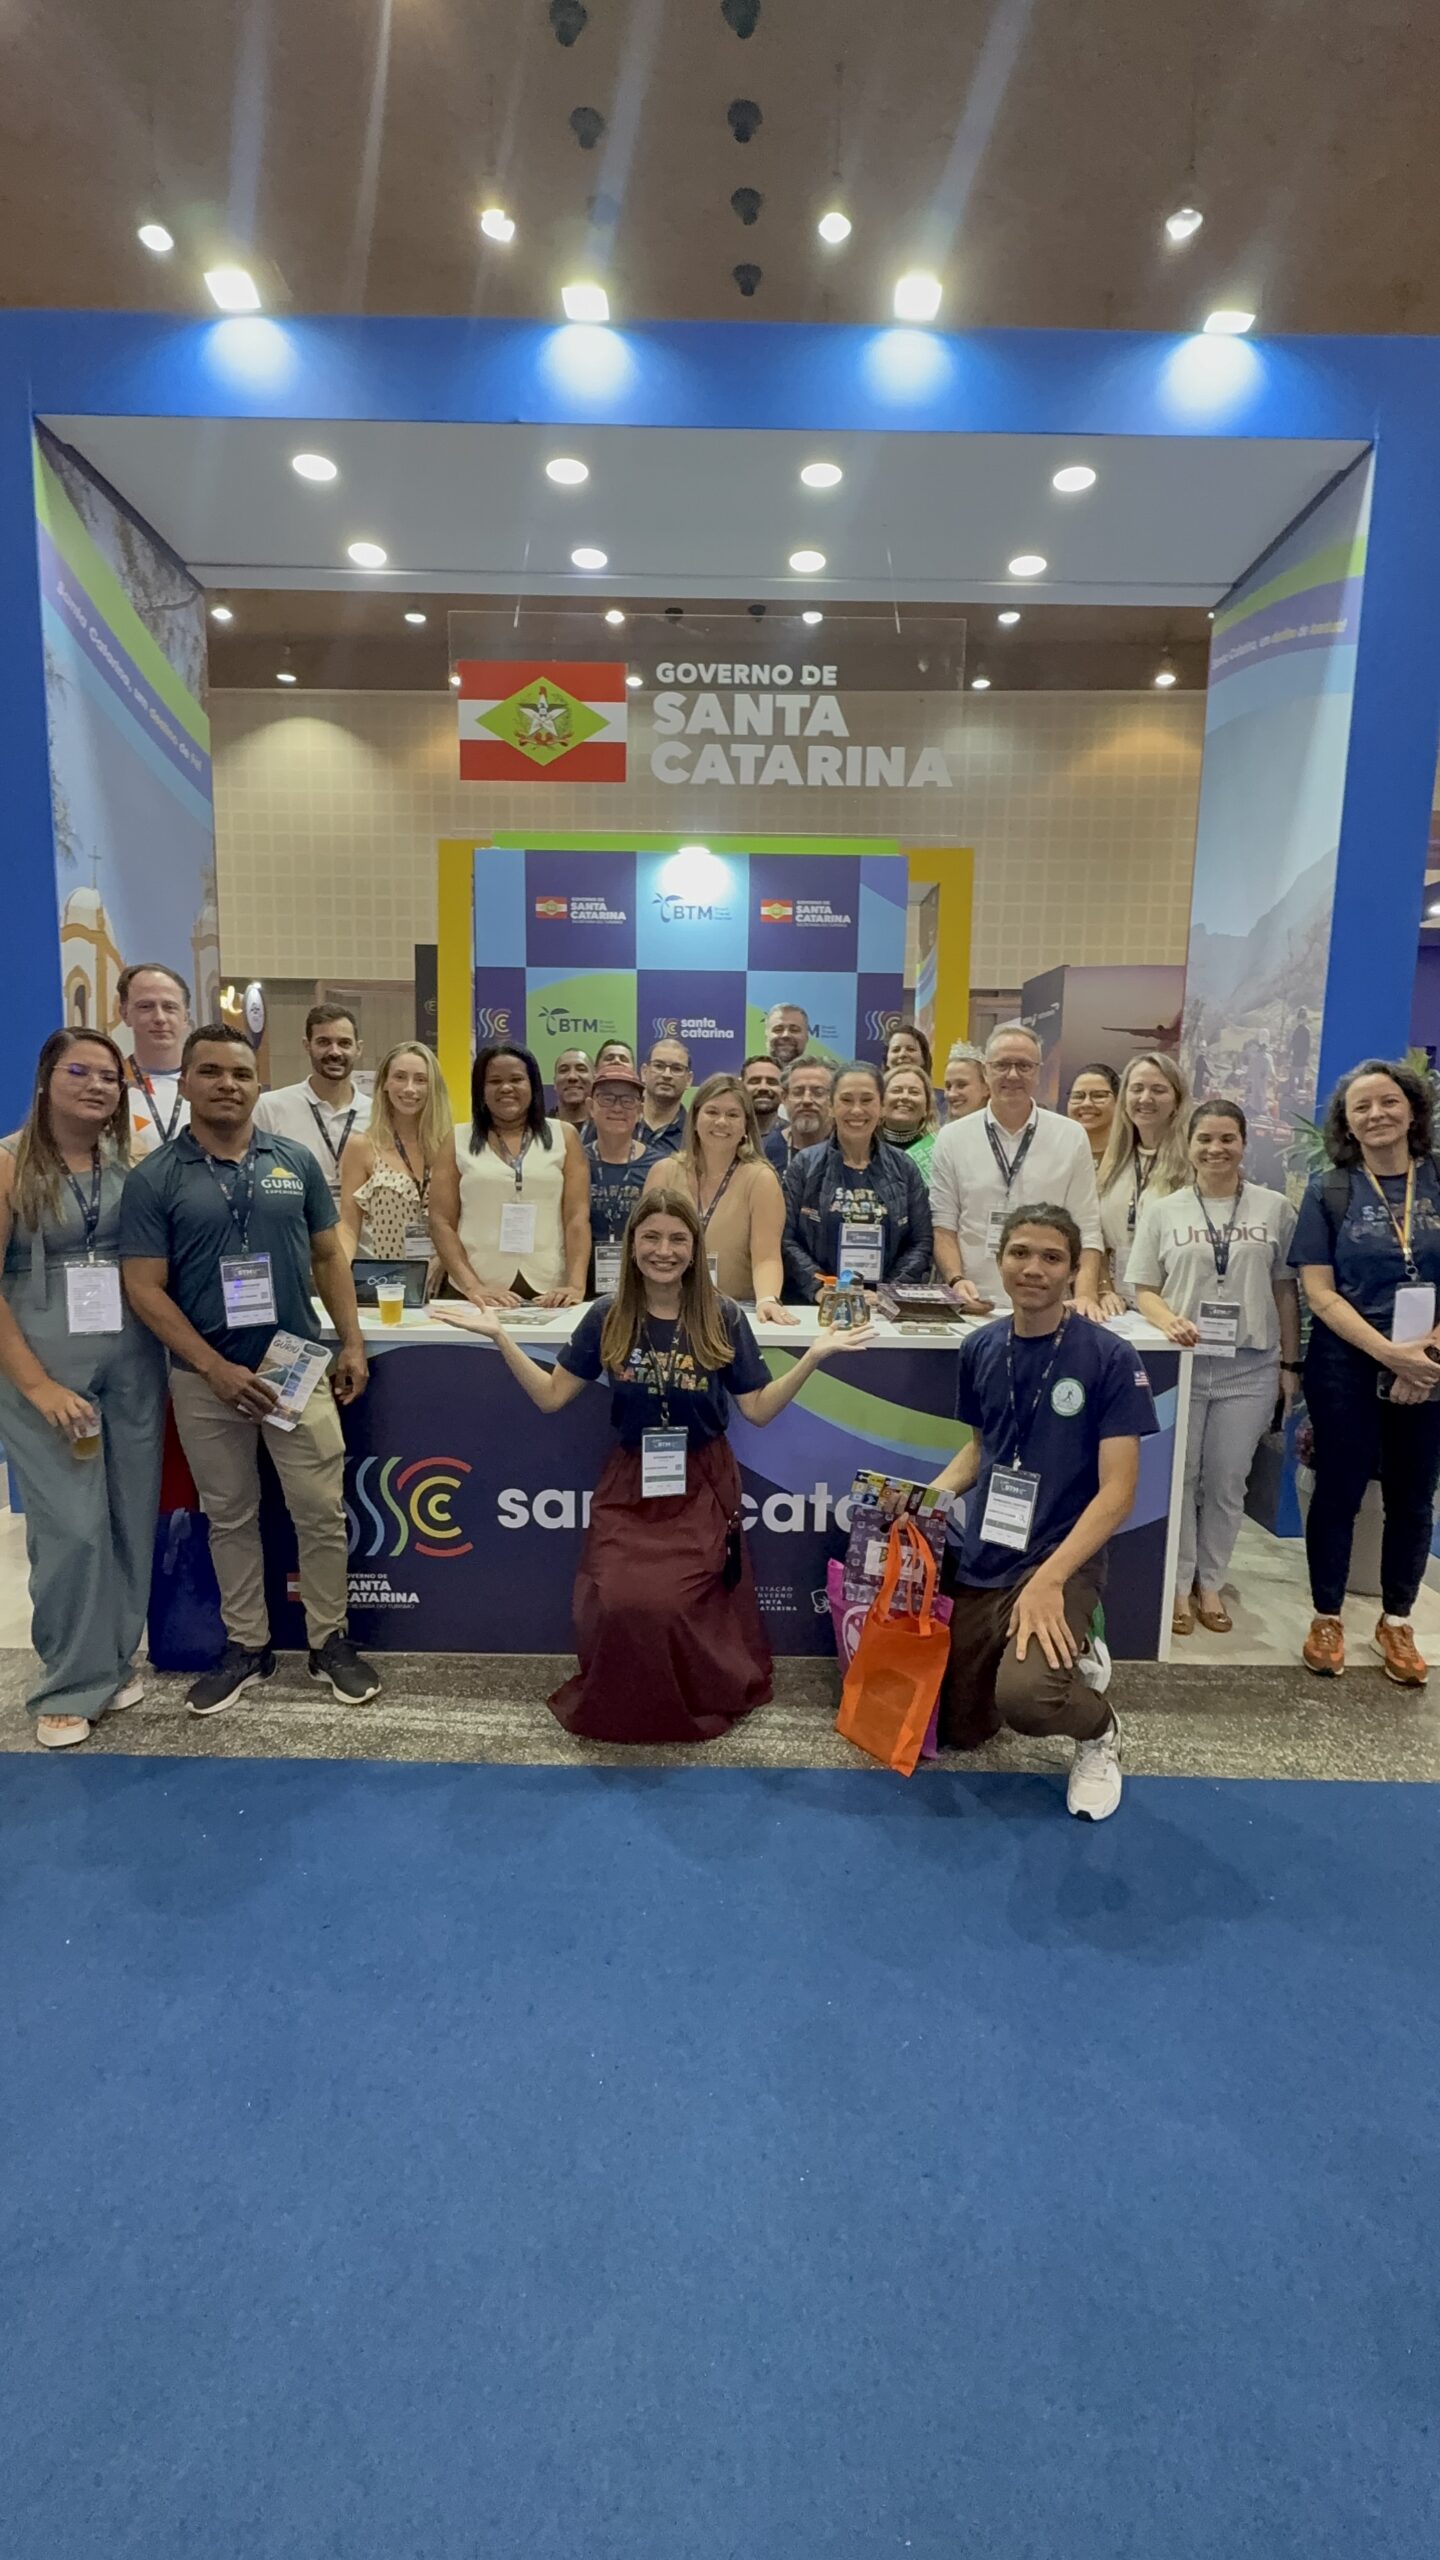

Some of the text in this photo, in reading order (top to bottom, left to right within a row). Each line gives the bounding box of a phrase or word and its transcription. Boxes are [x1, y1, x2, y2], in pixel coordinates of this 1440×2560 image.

[656, 662, 838, 686] GOVERNO DE
[652, 691, 850, 737] SANTA
[650, 740, 953, 788] CATARINA
[570, 902, 607, 911] SANTA
[795, 905, 833, 914] SANTA
[570, 911, 627, 921] CATARINA
[674, 905, 713, 920] BTM
[795, 914, 852, 924] CATARINA
[559, 1018, 598, 1033] BTM
[681, 1017, 716, 1028] santa
[681, 1028, 735, 1039] catarina
[348, 1580, 392, 1591] ANTA
[347, 1592, 420, 1604] ATARINA
